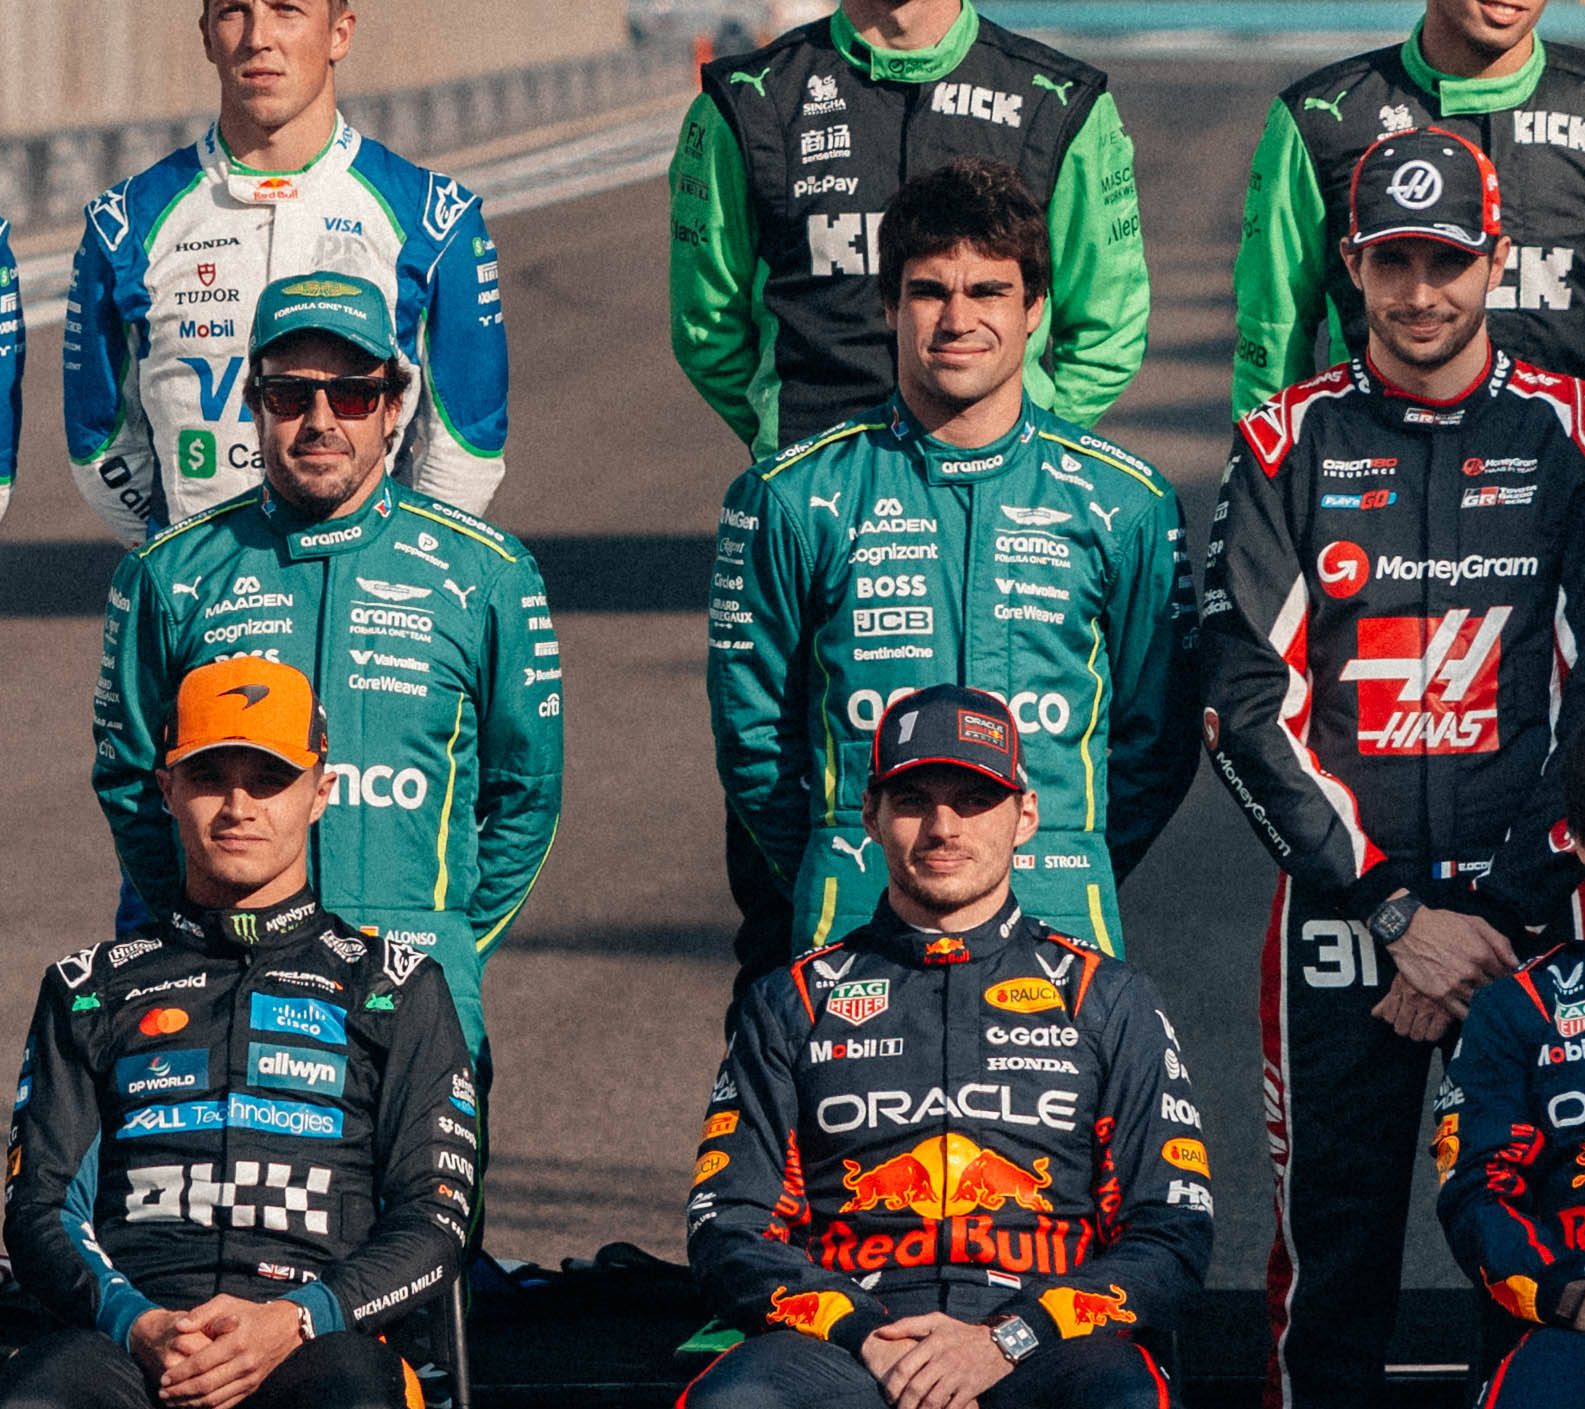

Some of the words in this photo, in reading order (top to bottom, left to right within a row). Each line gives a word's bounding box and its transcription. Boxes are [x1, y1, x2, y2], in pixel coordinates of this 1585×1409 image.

[803, 98, 846, 111] SINGHA
[932, 82, 1023, 128] KICK
[801, 125, 850, 155] 商汤
[324, 218, 363, 236] VISA
[175, 237, 240, 252] HONDA
[175, 289, 240, 305] TUDOR
[179, 319, 234, 339] Mobil
[942, 454, 1003, 473] aramco
[1081, 435, 1152, 477] coinbase
[1485, 457, 1537, 468] MoneyGram
[1323, 467, 1395, 477] INSURANCE
[433, 502, 504, 542] coinbase
[301, 526, 361, 548] aramco
[996, 537, 1068, 558] aramco
[395, 541, 449, 570] pepperstone
[849, 542, 938, 565] cognizant
[1376, 555, 1537, 585] MoneyGram
[857, 576, 927, 598] BOSS
[1015, 581, 1069, 600] Valvoline
[205, 594, 293, 618] MAADEN
[995, 604, 1064, 624] CoreWeave
[351, 608, 432, 631] aramco
[859, 611, 930, 632] JCB
[205, 618, 293, 644] cognizant
[374, 652, 429, 673] Valvoline
[854, 645, 932, 661] SentinelOne
[349, 675, 427, 698] CoreWeave
[898, 711, 919, 744] 1
[964, 715, 1003, 732] ORACLE
[1359, 711, 1497, 748] HAAS
[1215, 752, 1291, 858] MoneyGram
[1045, 855, 1090, 868] STROLL
[387, 931, 436, 946] ALONSO
[1302, 920, 1378, 988] 31
[126, 973, 206, 1000] Android
[838, 981, 884, 997] TAG
[829, 1000, 887, 1021] HEUER
[1011, 1027, 1078, 1048] Gate
[811, 1040, 877, 1063] Mobil
[259, 1055, 335, 1082] allwyn
[988, 1057, 1078, 1073] HONDA
[129, 1079, 146, 1093] DP
[147, 1074, 194, 1091] WORLD
[817, 1084, 1078, 1133] ORACLE
[822, 1213, 937, 1271] Red
[951, 1216, 1068, 1274] Bull
[354, 1287, 409, 1320] RICHARD
[410, 1266, 444, 1297] MILLE
